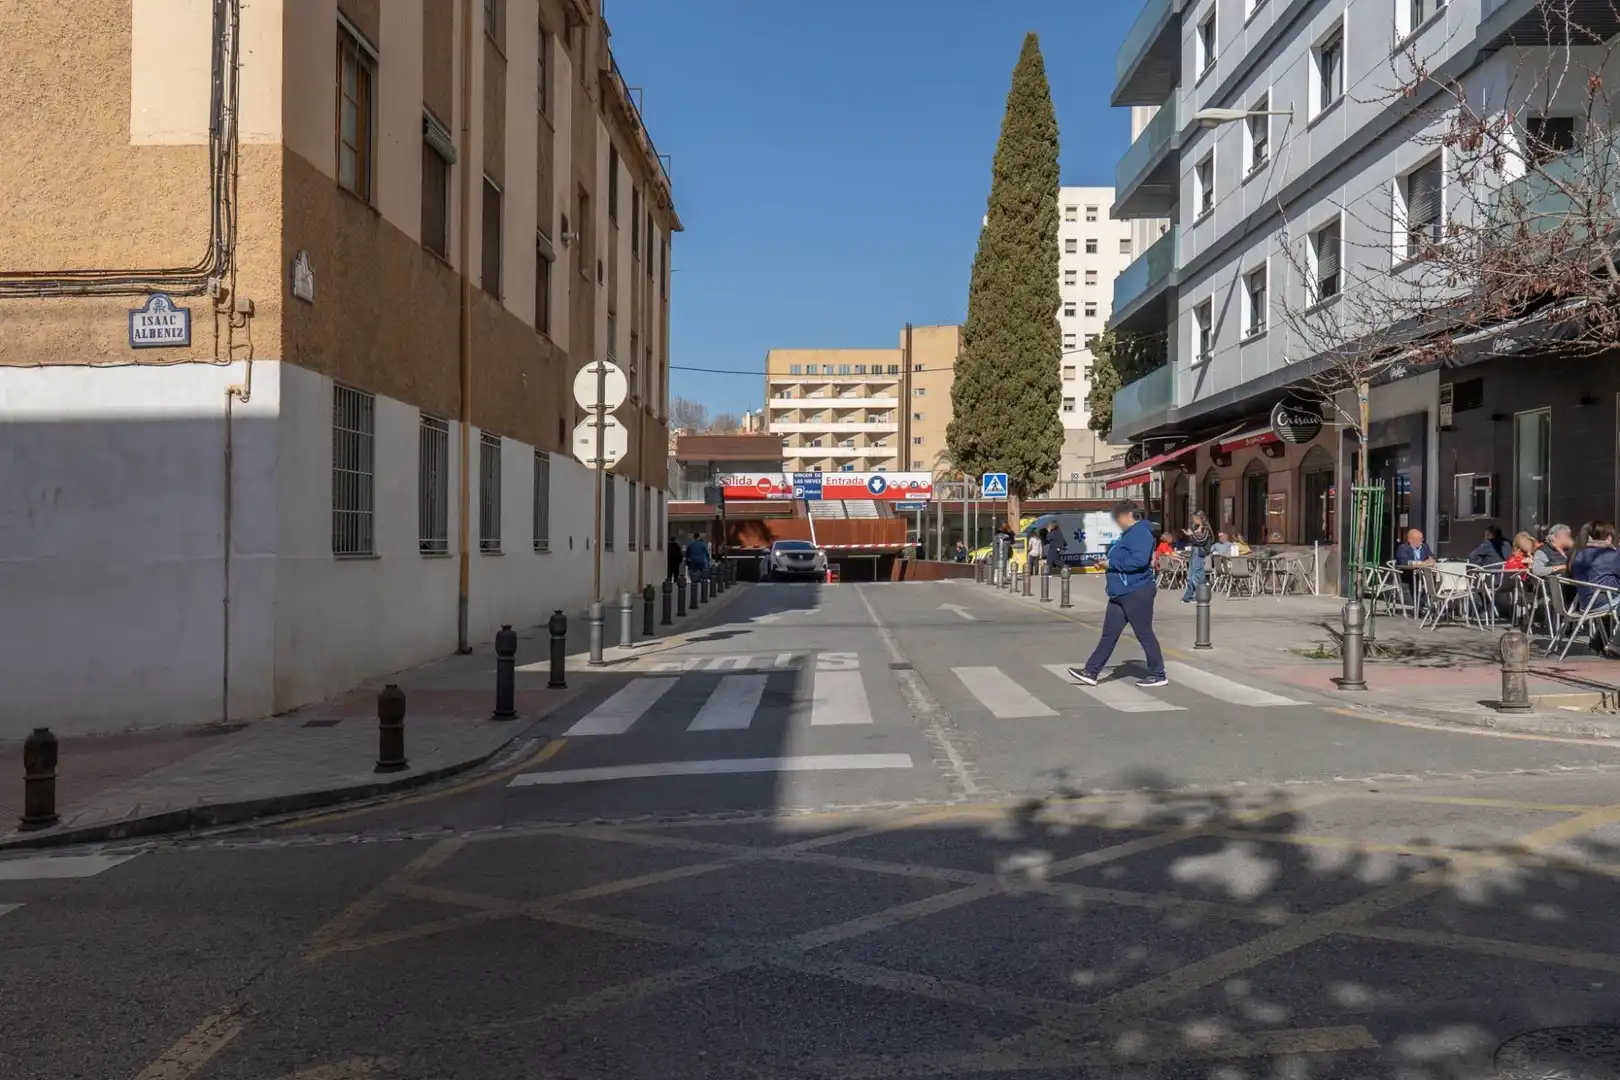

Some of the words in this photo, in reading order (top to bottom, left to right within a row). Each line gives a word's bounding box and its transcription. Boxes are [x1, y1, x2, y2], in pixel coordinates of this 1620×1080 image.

[141, 315, 176, 326] ISAAC
[134, 328, 184, 339] ALBENIZ
[719, 475, 752, 486] Salida
[826, 476, 864, 485] Entrada
[795, 487, 803, 497] P
